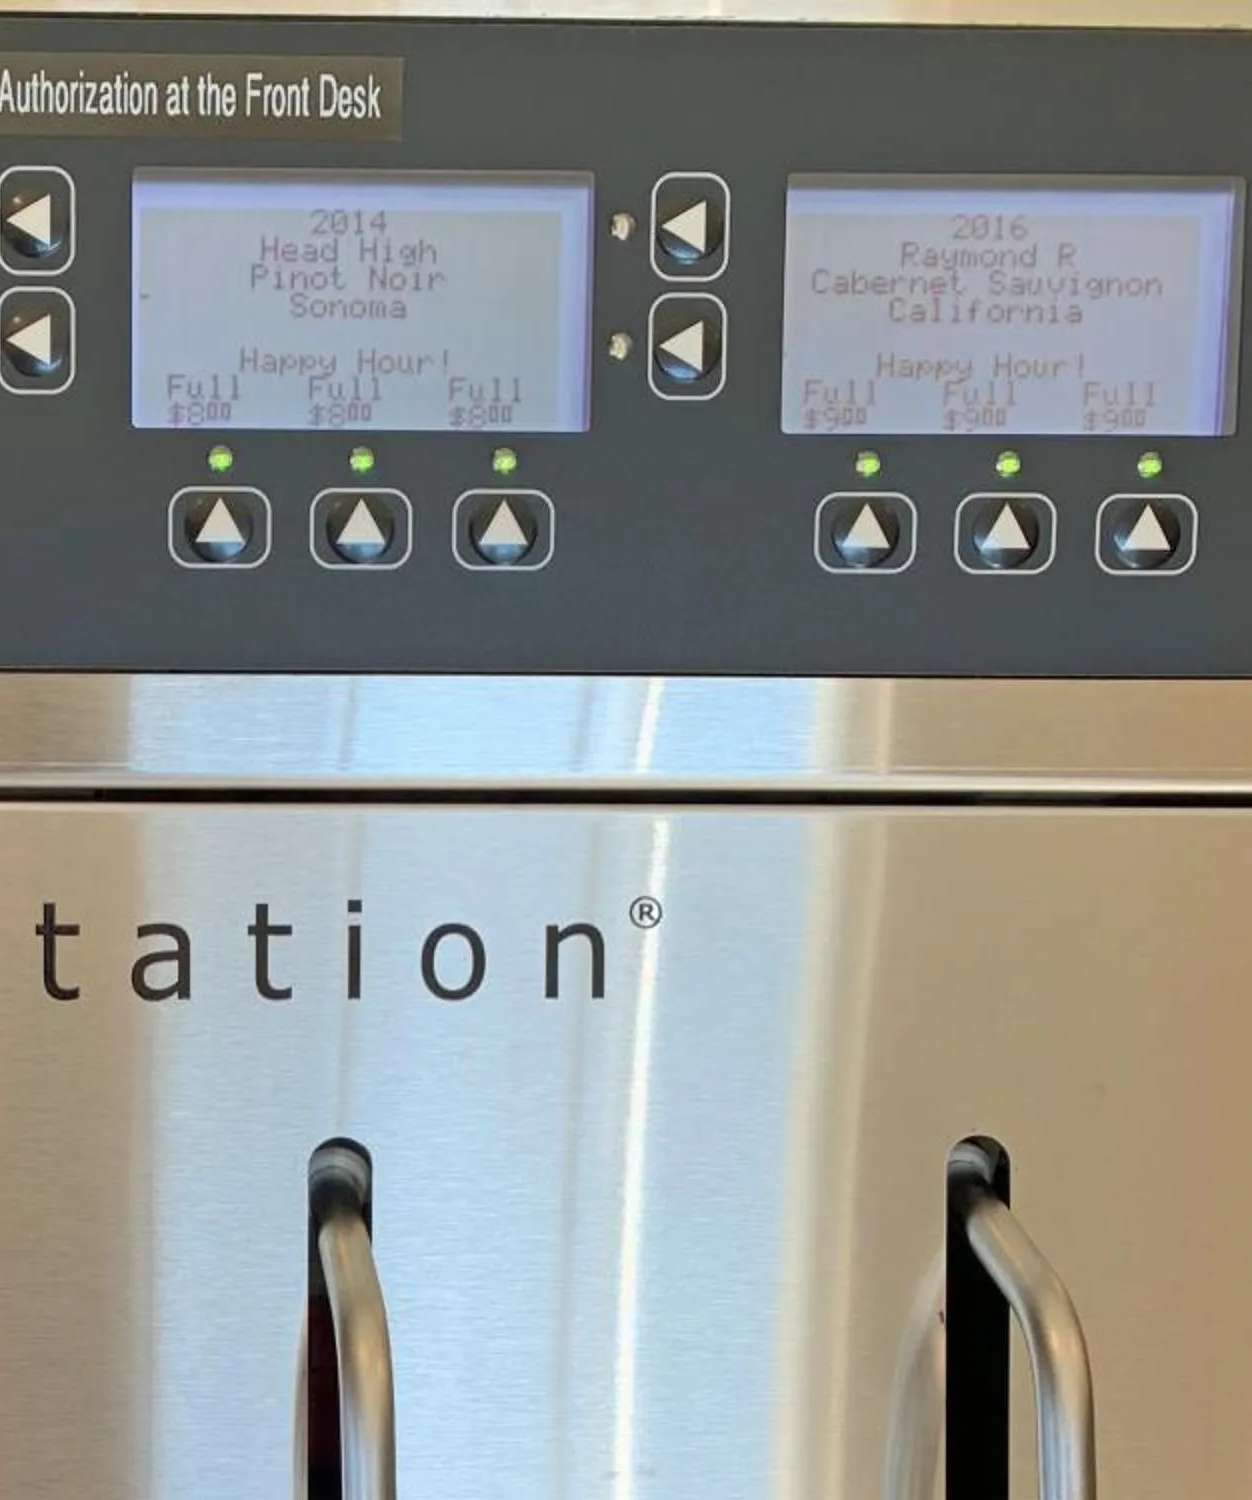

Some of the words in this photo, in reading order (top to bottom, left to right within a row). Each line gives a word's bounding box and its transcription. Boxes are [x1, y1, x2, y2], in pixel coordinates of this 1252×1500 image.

[166, 77, 190, 115] at
[198, 74, 236, 117] the
[246, 73, 310, 118] Front
[320, 75, 380, 119] Desk
[310, 210, 387, 235] 2014
[953, 214, 1028, 241] 2016
[261, 236, 338, 263] Head
[359, 238, 437, 266] High
[901, 241, 1037, 271] Raymond
[1058, 243, 1077, 268] R
[252, 264, 346, 291] Pinot
[370, 267, 444, 292] Noir
[811, 269, 965, 295] Cabernet
[988, 271, 1163, 299] Sauvignon
[290, 293, 407, 320] Sonoma
[889, 297, 1083, 325] California
[240, 347, 336, 377] Happy
[358, 348, 449, 374] Hour!
[876, 353, 973, 382] Happy
[994, 354, 1085, 379] Hour!
[168, 375, 241, 401] Full
[309, 376, 382, 402] Full
[450, 377, 522, 403] Full
[803, 379, 875, 406] Full
[943, 380, 1015, 406] Full
[1083, 381, 1155, 407] Full
